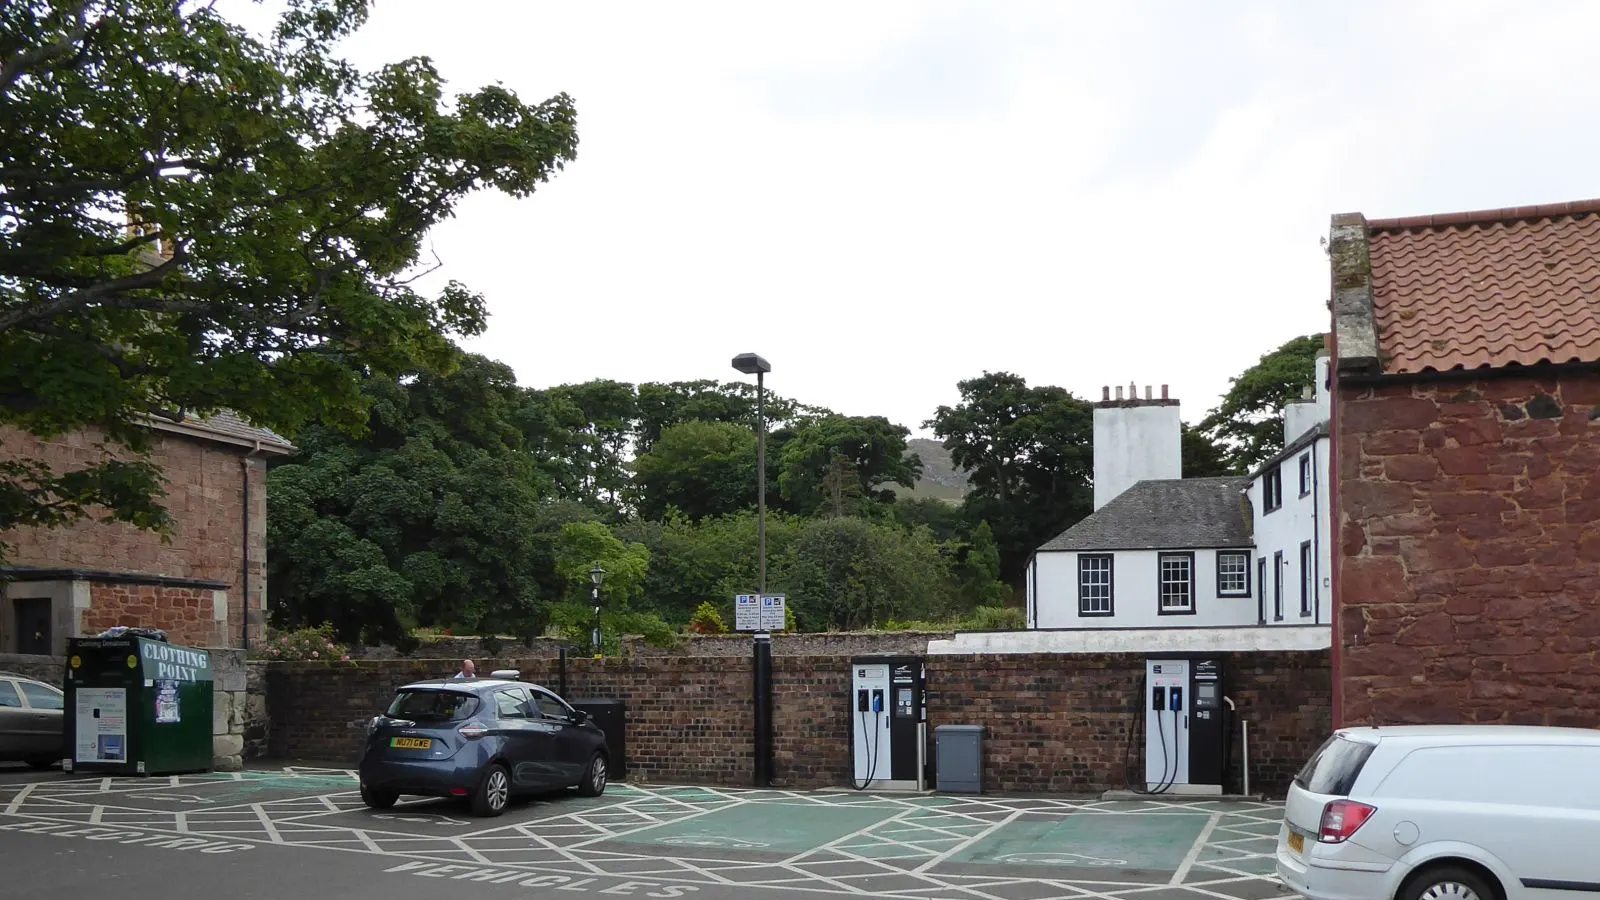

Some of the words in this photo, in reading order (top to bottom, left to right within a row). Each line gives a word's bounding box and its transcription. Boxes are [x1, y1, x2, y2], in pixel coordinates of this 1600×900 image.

[144, 643, 207, 669] CLOTHING
[158, 662, 197, 682] POINT
[413, 739, 429, 748] GWE
[0, 821, 256, 853] ELECTRIC
[383, 861, 700, 898] VEHICLES
